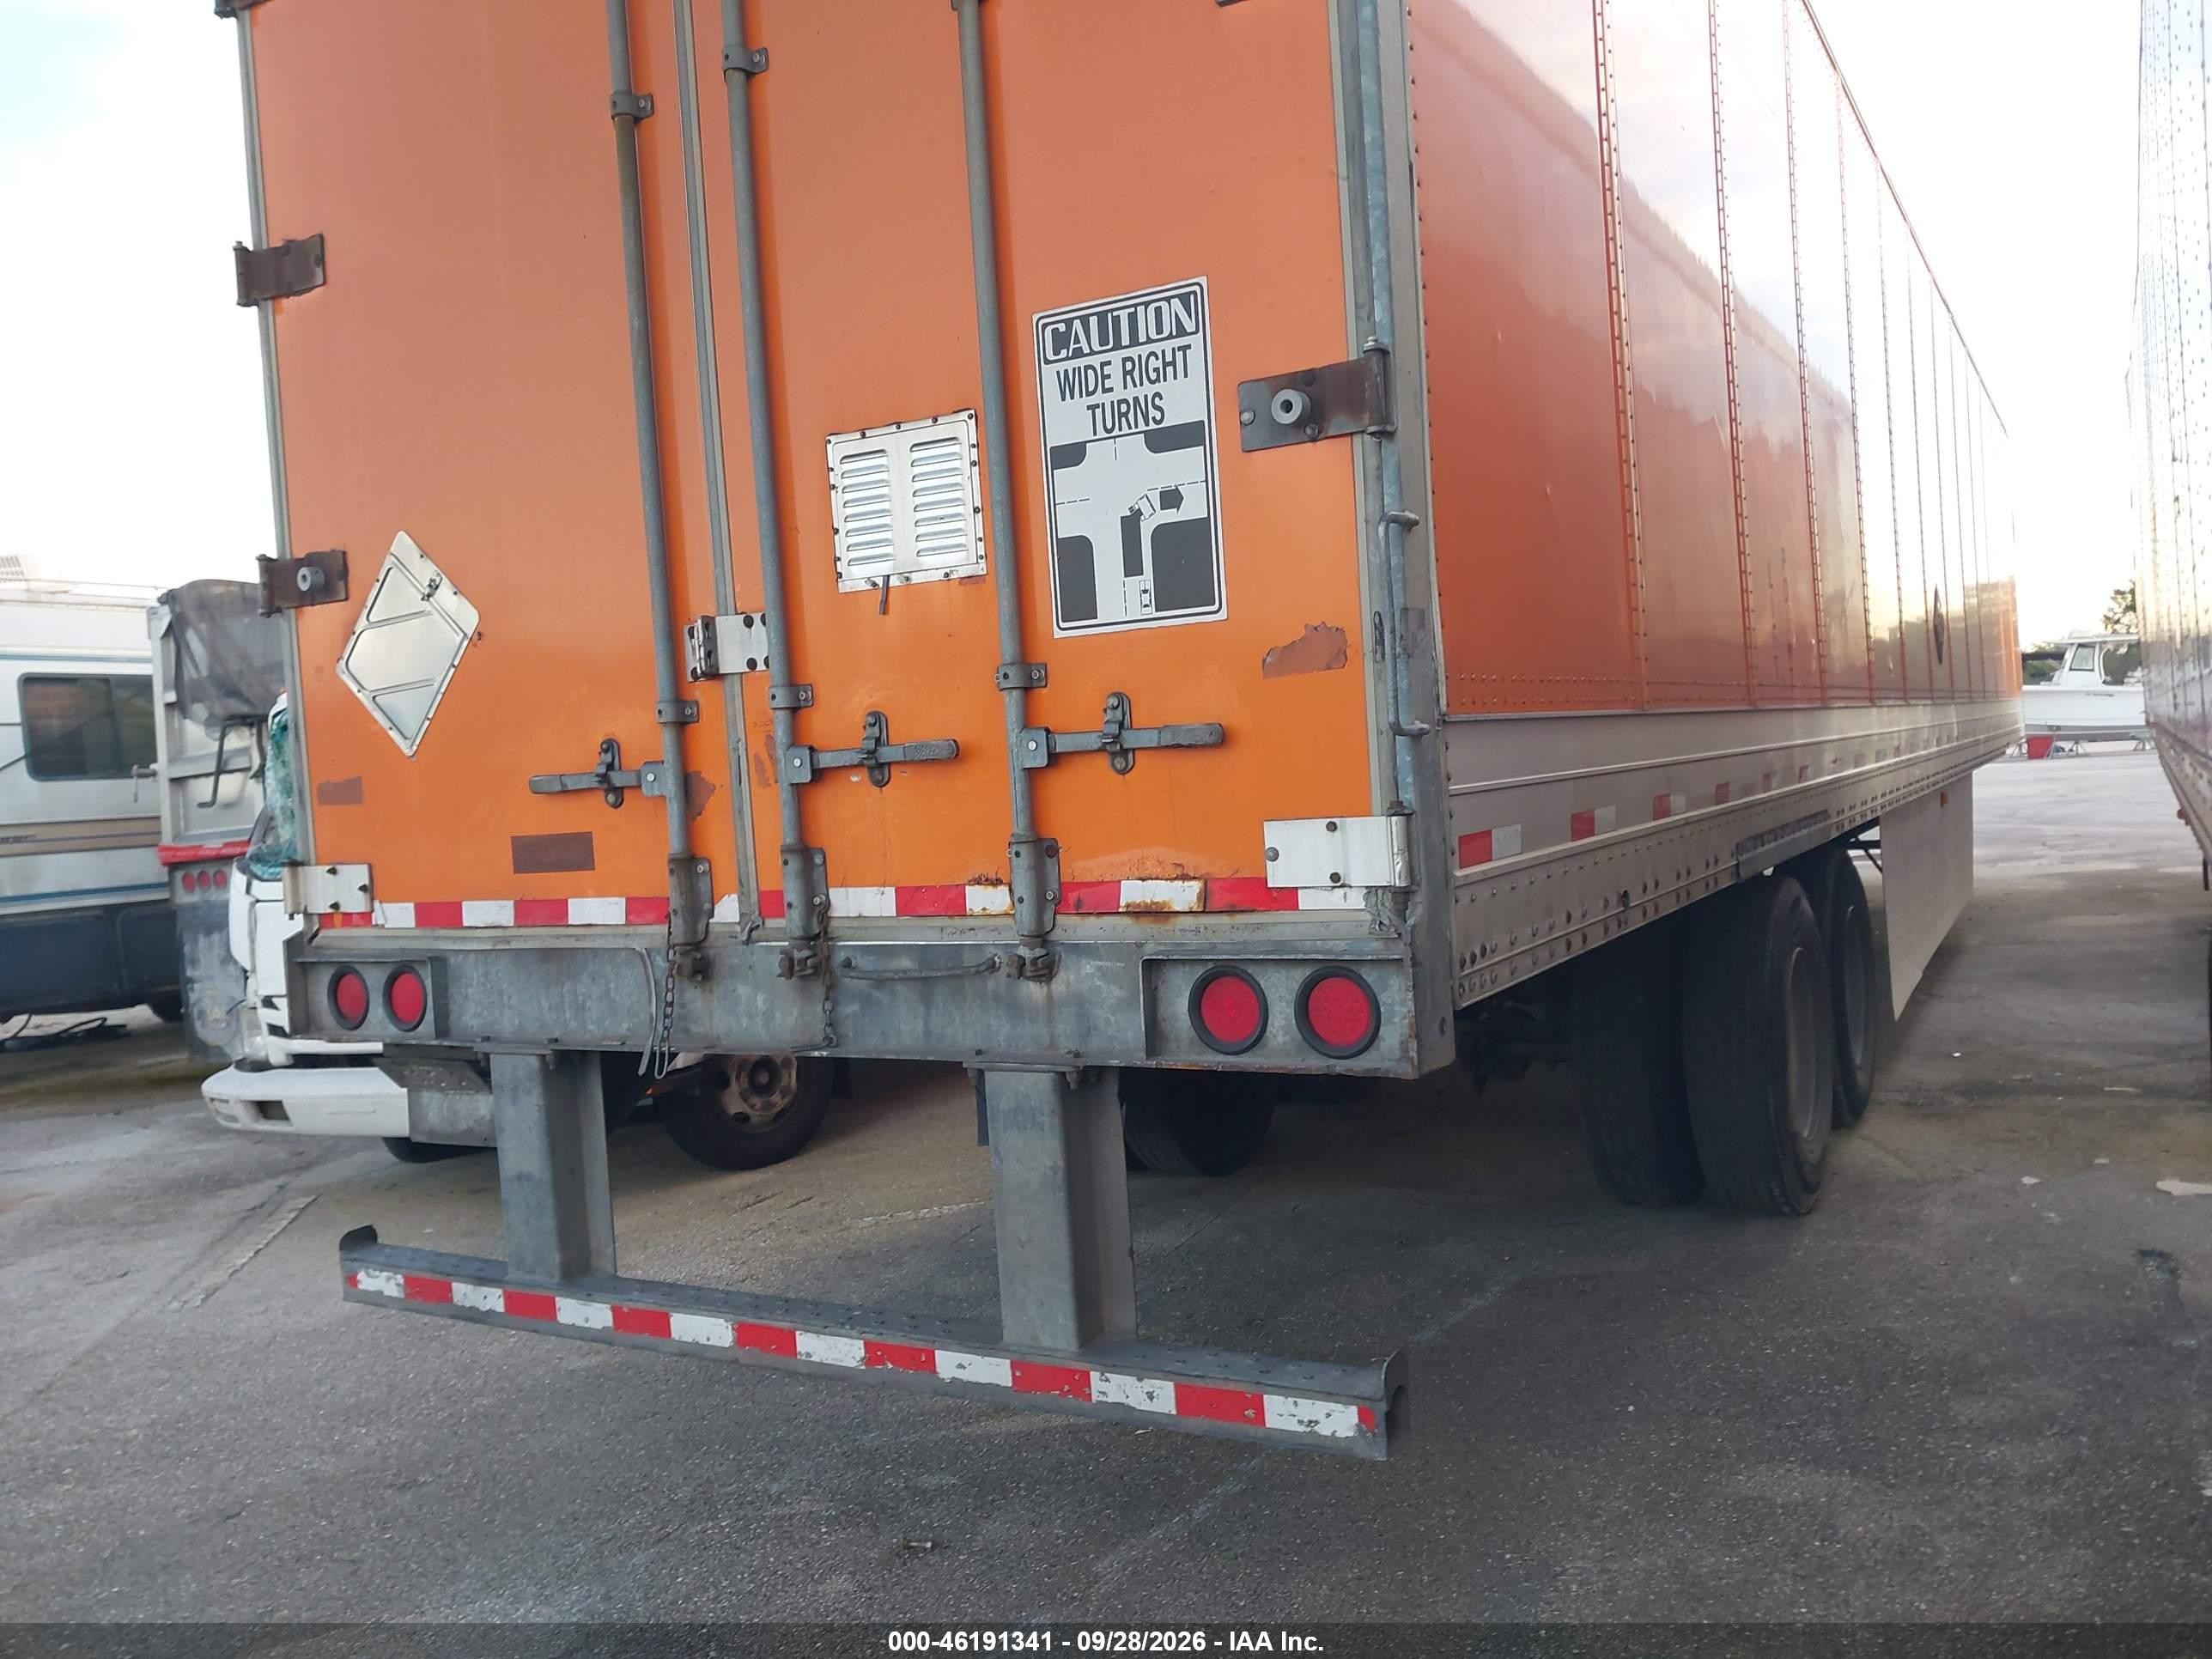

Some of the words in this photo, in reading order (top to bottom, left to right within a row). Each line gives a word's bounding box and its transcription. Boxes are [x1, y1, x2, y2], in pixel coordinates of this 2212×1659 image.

[1043, 294, 1196, 362] CAUTION
[1055, 360, 1115, 403] WIDE
[1121, 343, 1192, 391] RIGHT
[1085, 392, 1165, 436] TURNS
